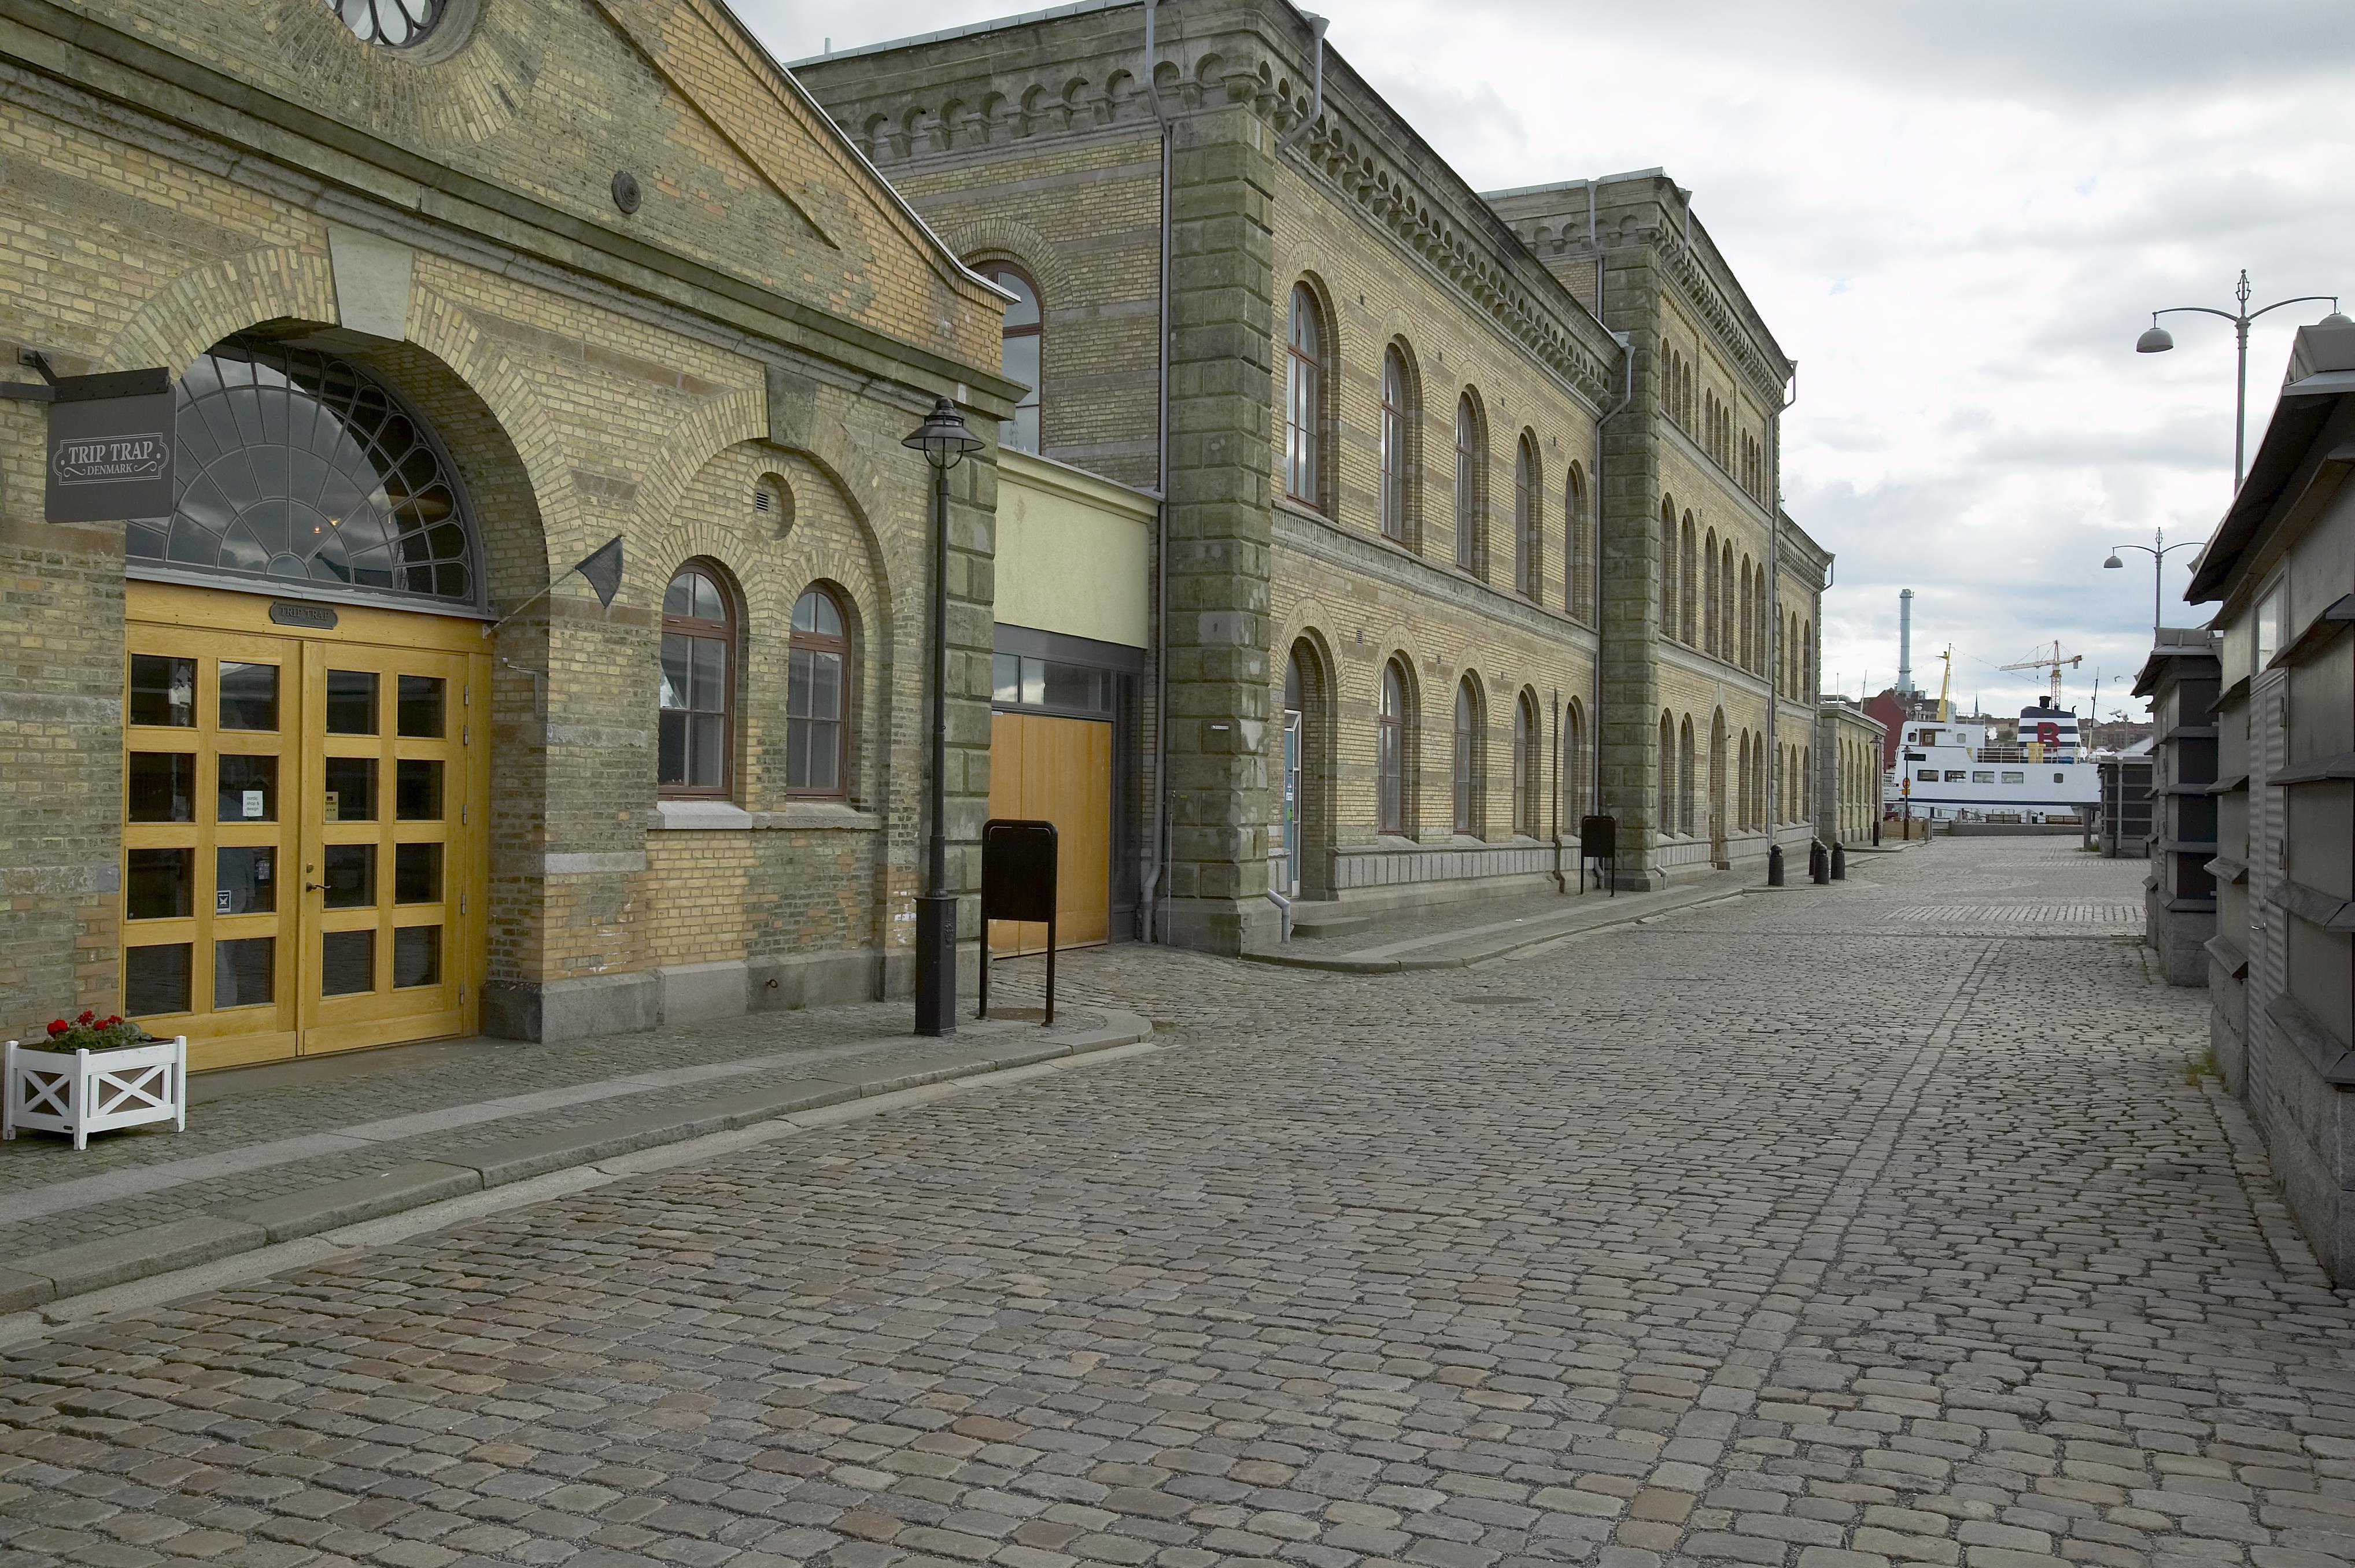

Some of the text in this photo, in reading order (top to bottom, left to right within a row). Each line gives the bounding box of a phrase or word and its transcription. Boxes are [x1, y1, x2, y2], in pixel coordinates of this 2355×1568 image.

[68, 441, 153, 464] TRIP TRAP
[87, 463, 132, 475] DENMARK
[280, 606, 330, 620] TRIP TRAP
